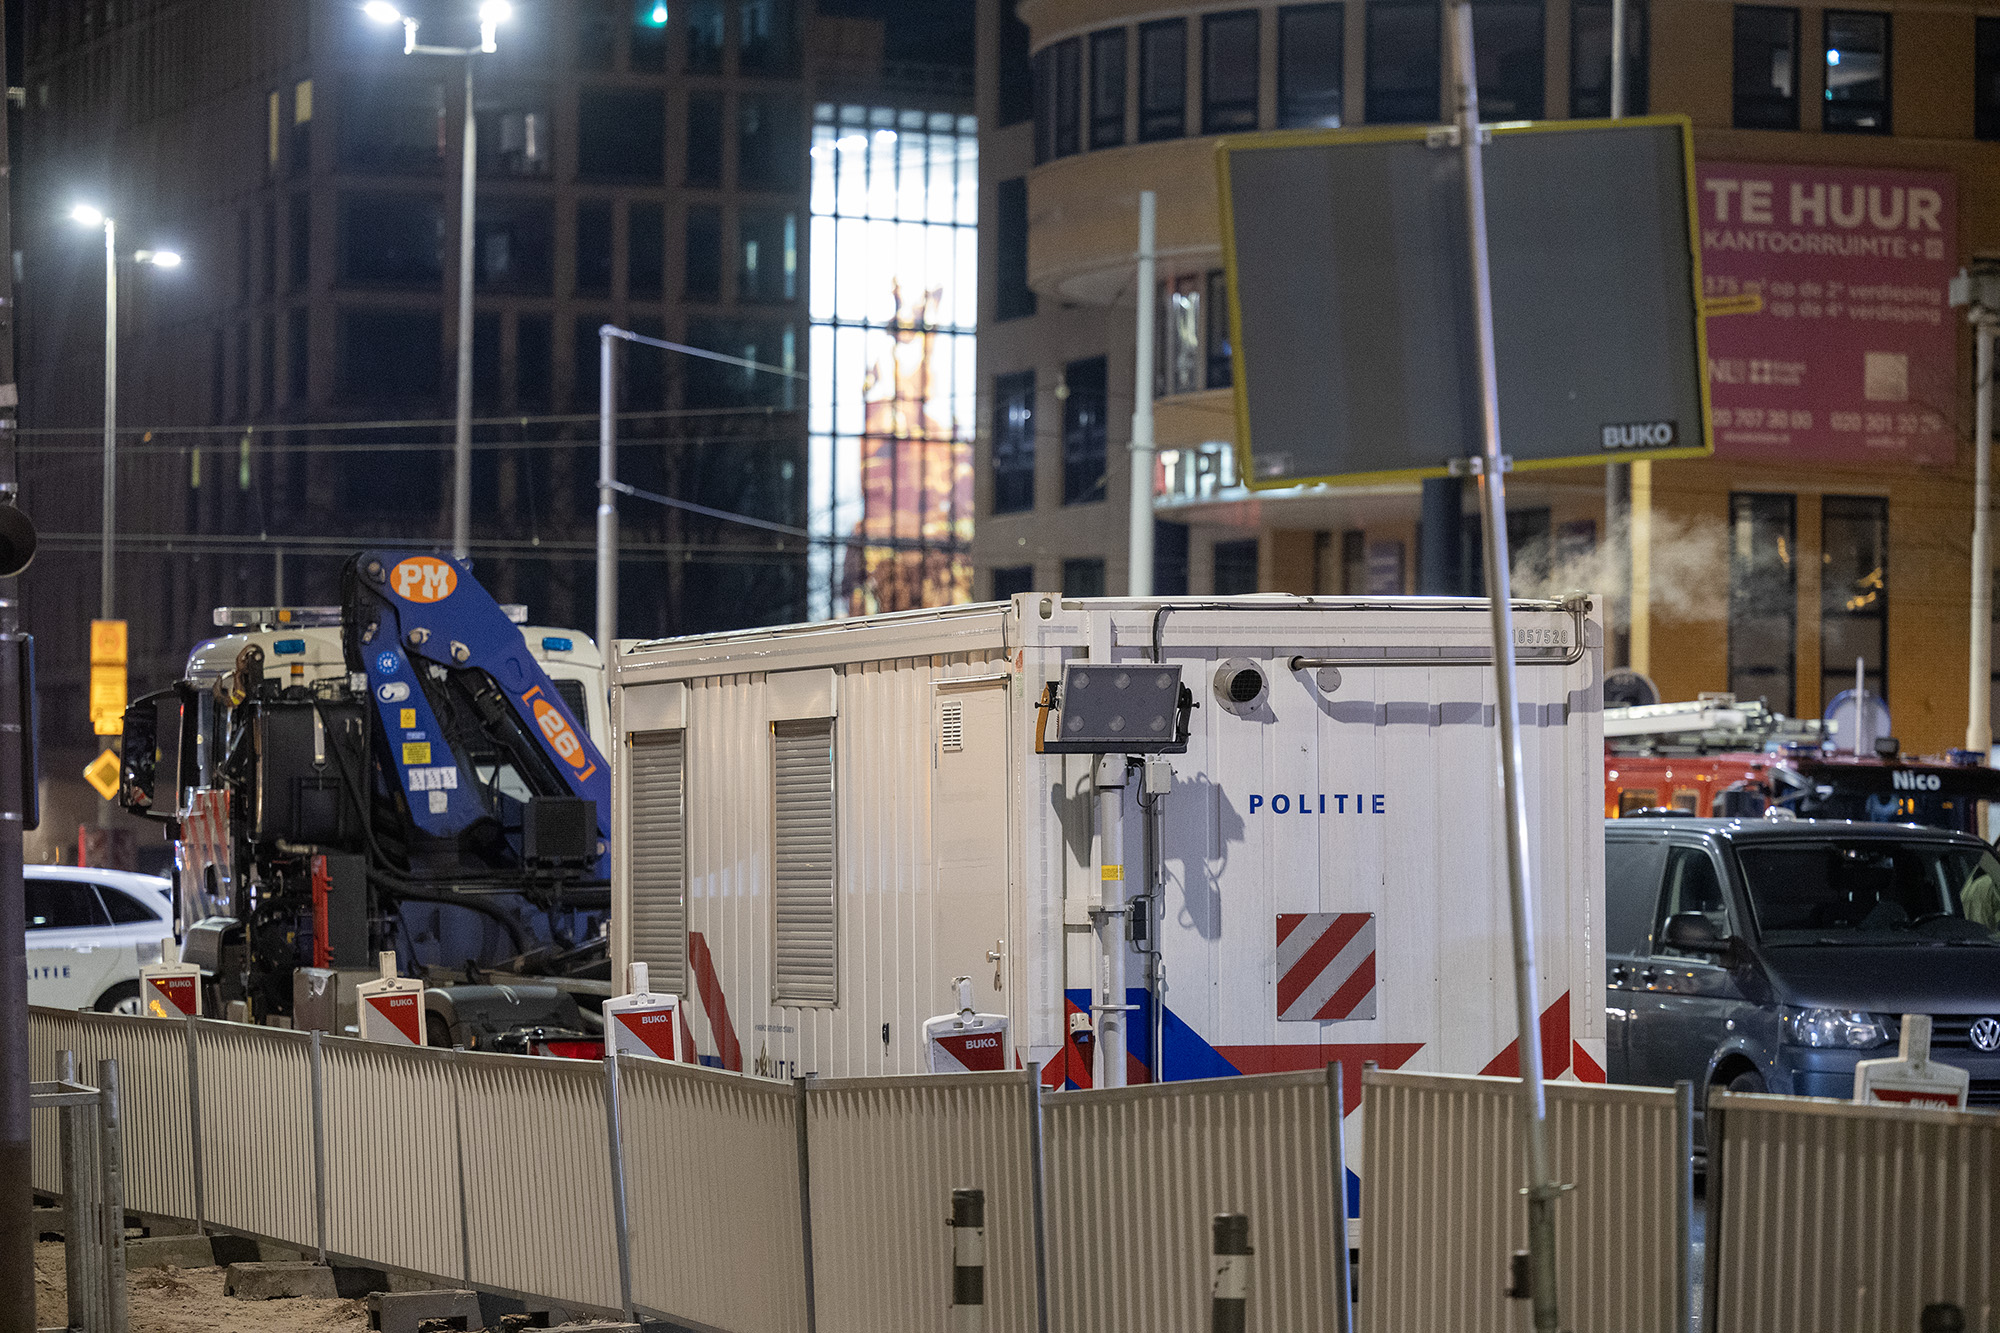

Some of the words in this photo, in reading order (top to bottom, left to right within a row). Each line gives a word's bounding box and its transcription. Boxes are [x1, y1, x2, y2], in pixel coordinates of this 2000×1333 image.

[1705, 179, 1773, 224] TE
[1790, 182, 1943, 232] HUUR
[1704, 230, 1907, 259] KANTOORRUIMTE
[1602, 422, 1673, 448] BUKO
[398, 564, 449, 600] PM
[1892, 769, 1941, 791] Nico
[1249, 794, 1385, 815] POLITIE
